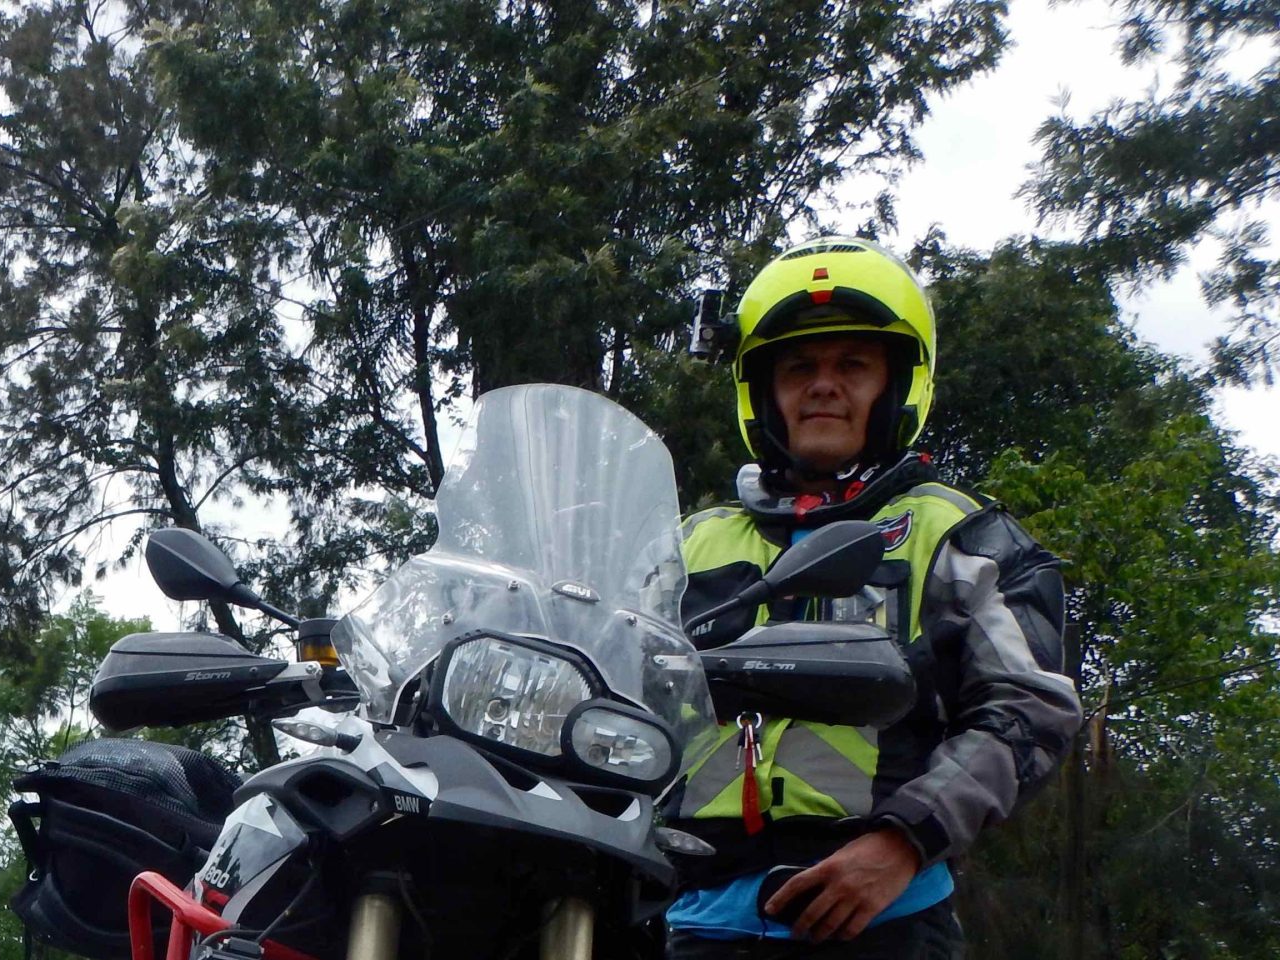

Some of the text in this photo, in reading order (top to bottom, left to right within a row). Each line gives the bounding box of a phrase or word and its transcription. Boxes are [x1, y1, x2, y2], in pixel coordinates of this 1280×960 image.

[183, 671, 232, 682] Storm
[393, 794, 421, 814] BMW
[204, 865, 231, 889] 800
